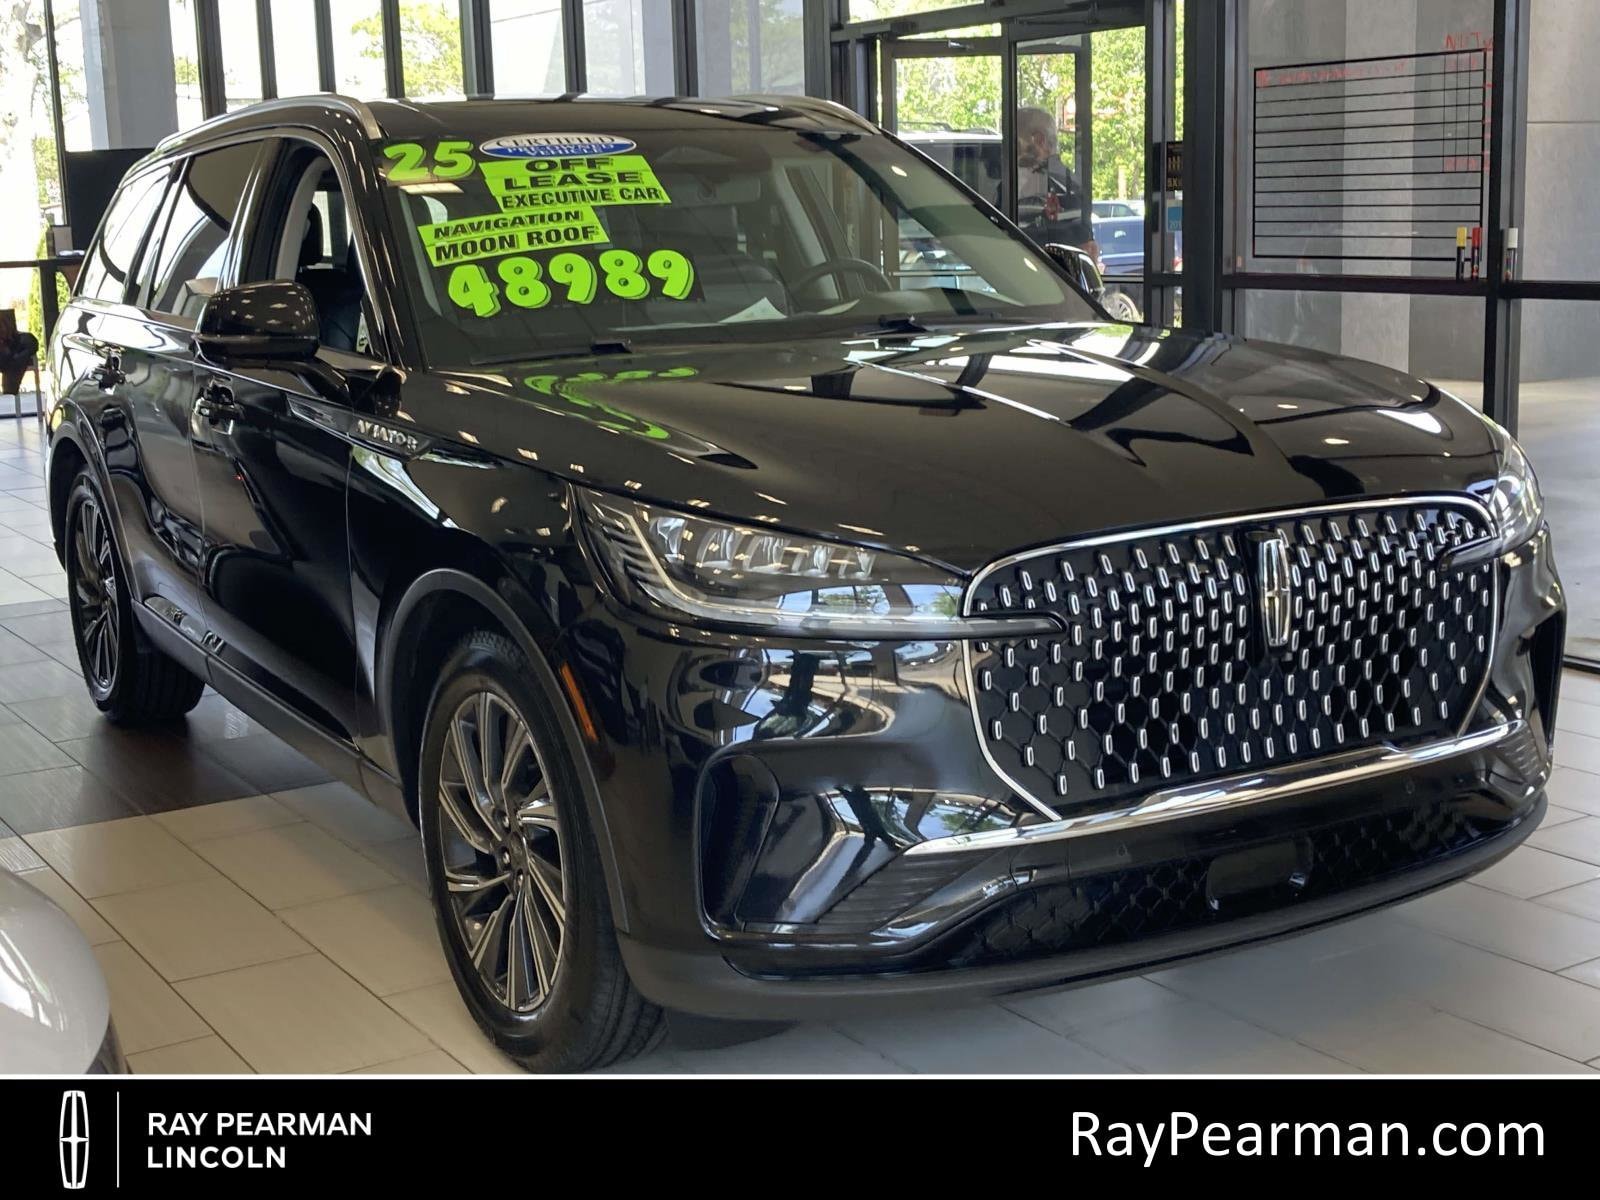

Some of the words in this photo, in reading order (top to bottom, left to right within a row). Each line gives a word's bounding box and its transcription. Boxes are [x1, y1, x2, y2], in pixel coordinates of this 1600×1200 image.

[383, 141, 475, 181] 25
[525, 157, 613, 173] OFF
[504, 171, 642, 191] LEASE
[502, 189, 615, 210] EXECUTIVE
[619, 187, 664, 201] CAR
[433, 209, 583, 239] NAVIGATION
[435, 233, 520, 262] MOON
[527, 225, 600, 247] ROOF
[448, 249, 695, 317] 48989
[356, 419, 419, 450] AVIATOR
